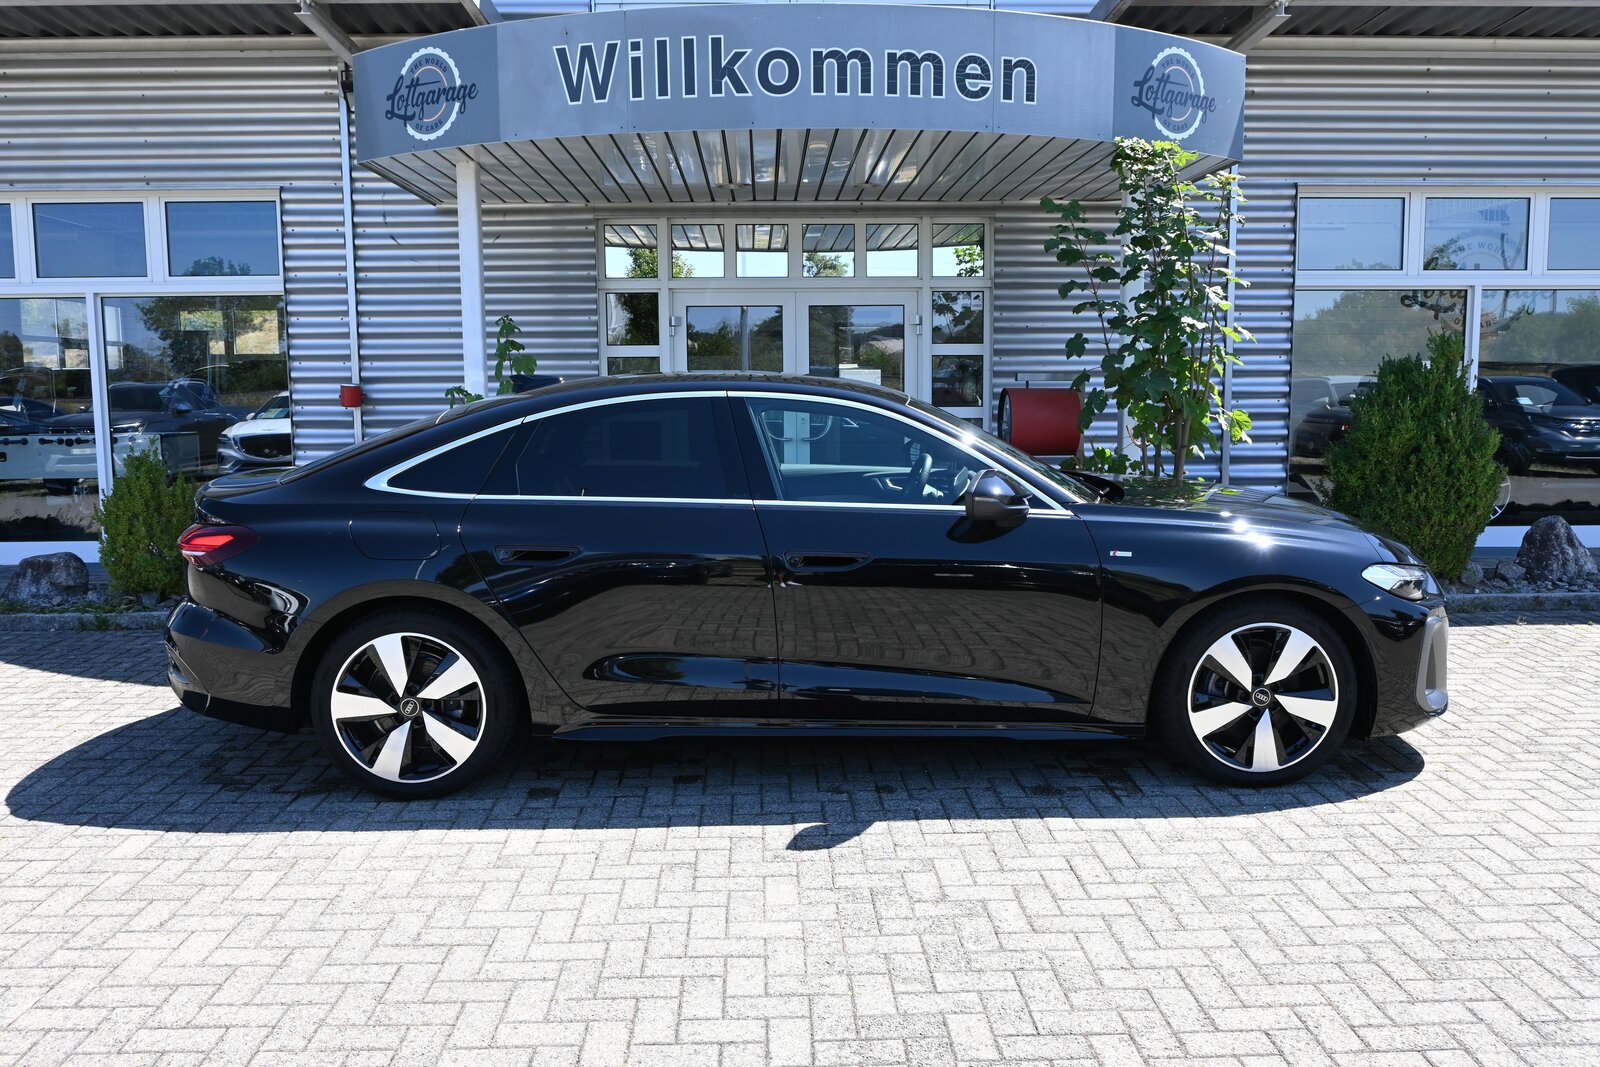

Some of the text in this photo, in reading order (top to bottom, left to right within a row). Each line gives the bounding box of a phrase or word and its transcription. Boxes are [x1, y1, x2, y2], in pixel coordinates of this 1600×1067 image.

[410, 58, 448, 74] THE WORLD
[552, 33, 1038, 106] Willkommen
[385, 74, 479, 127] Loftgarage
[1131, 65, 1217, 124] Loftgarage
